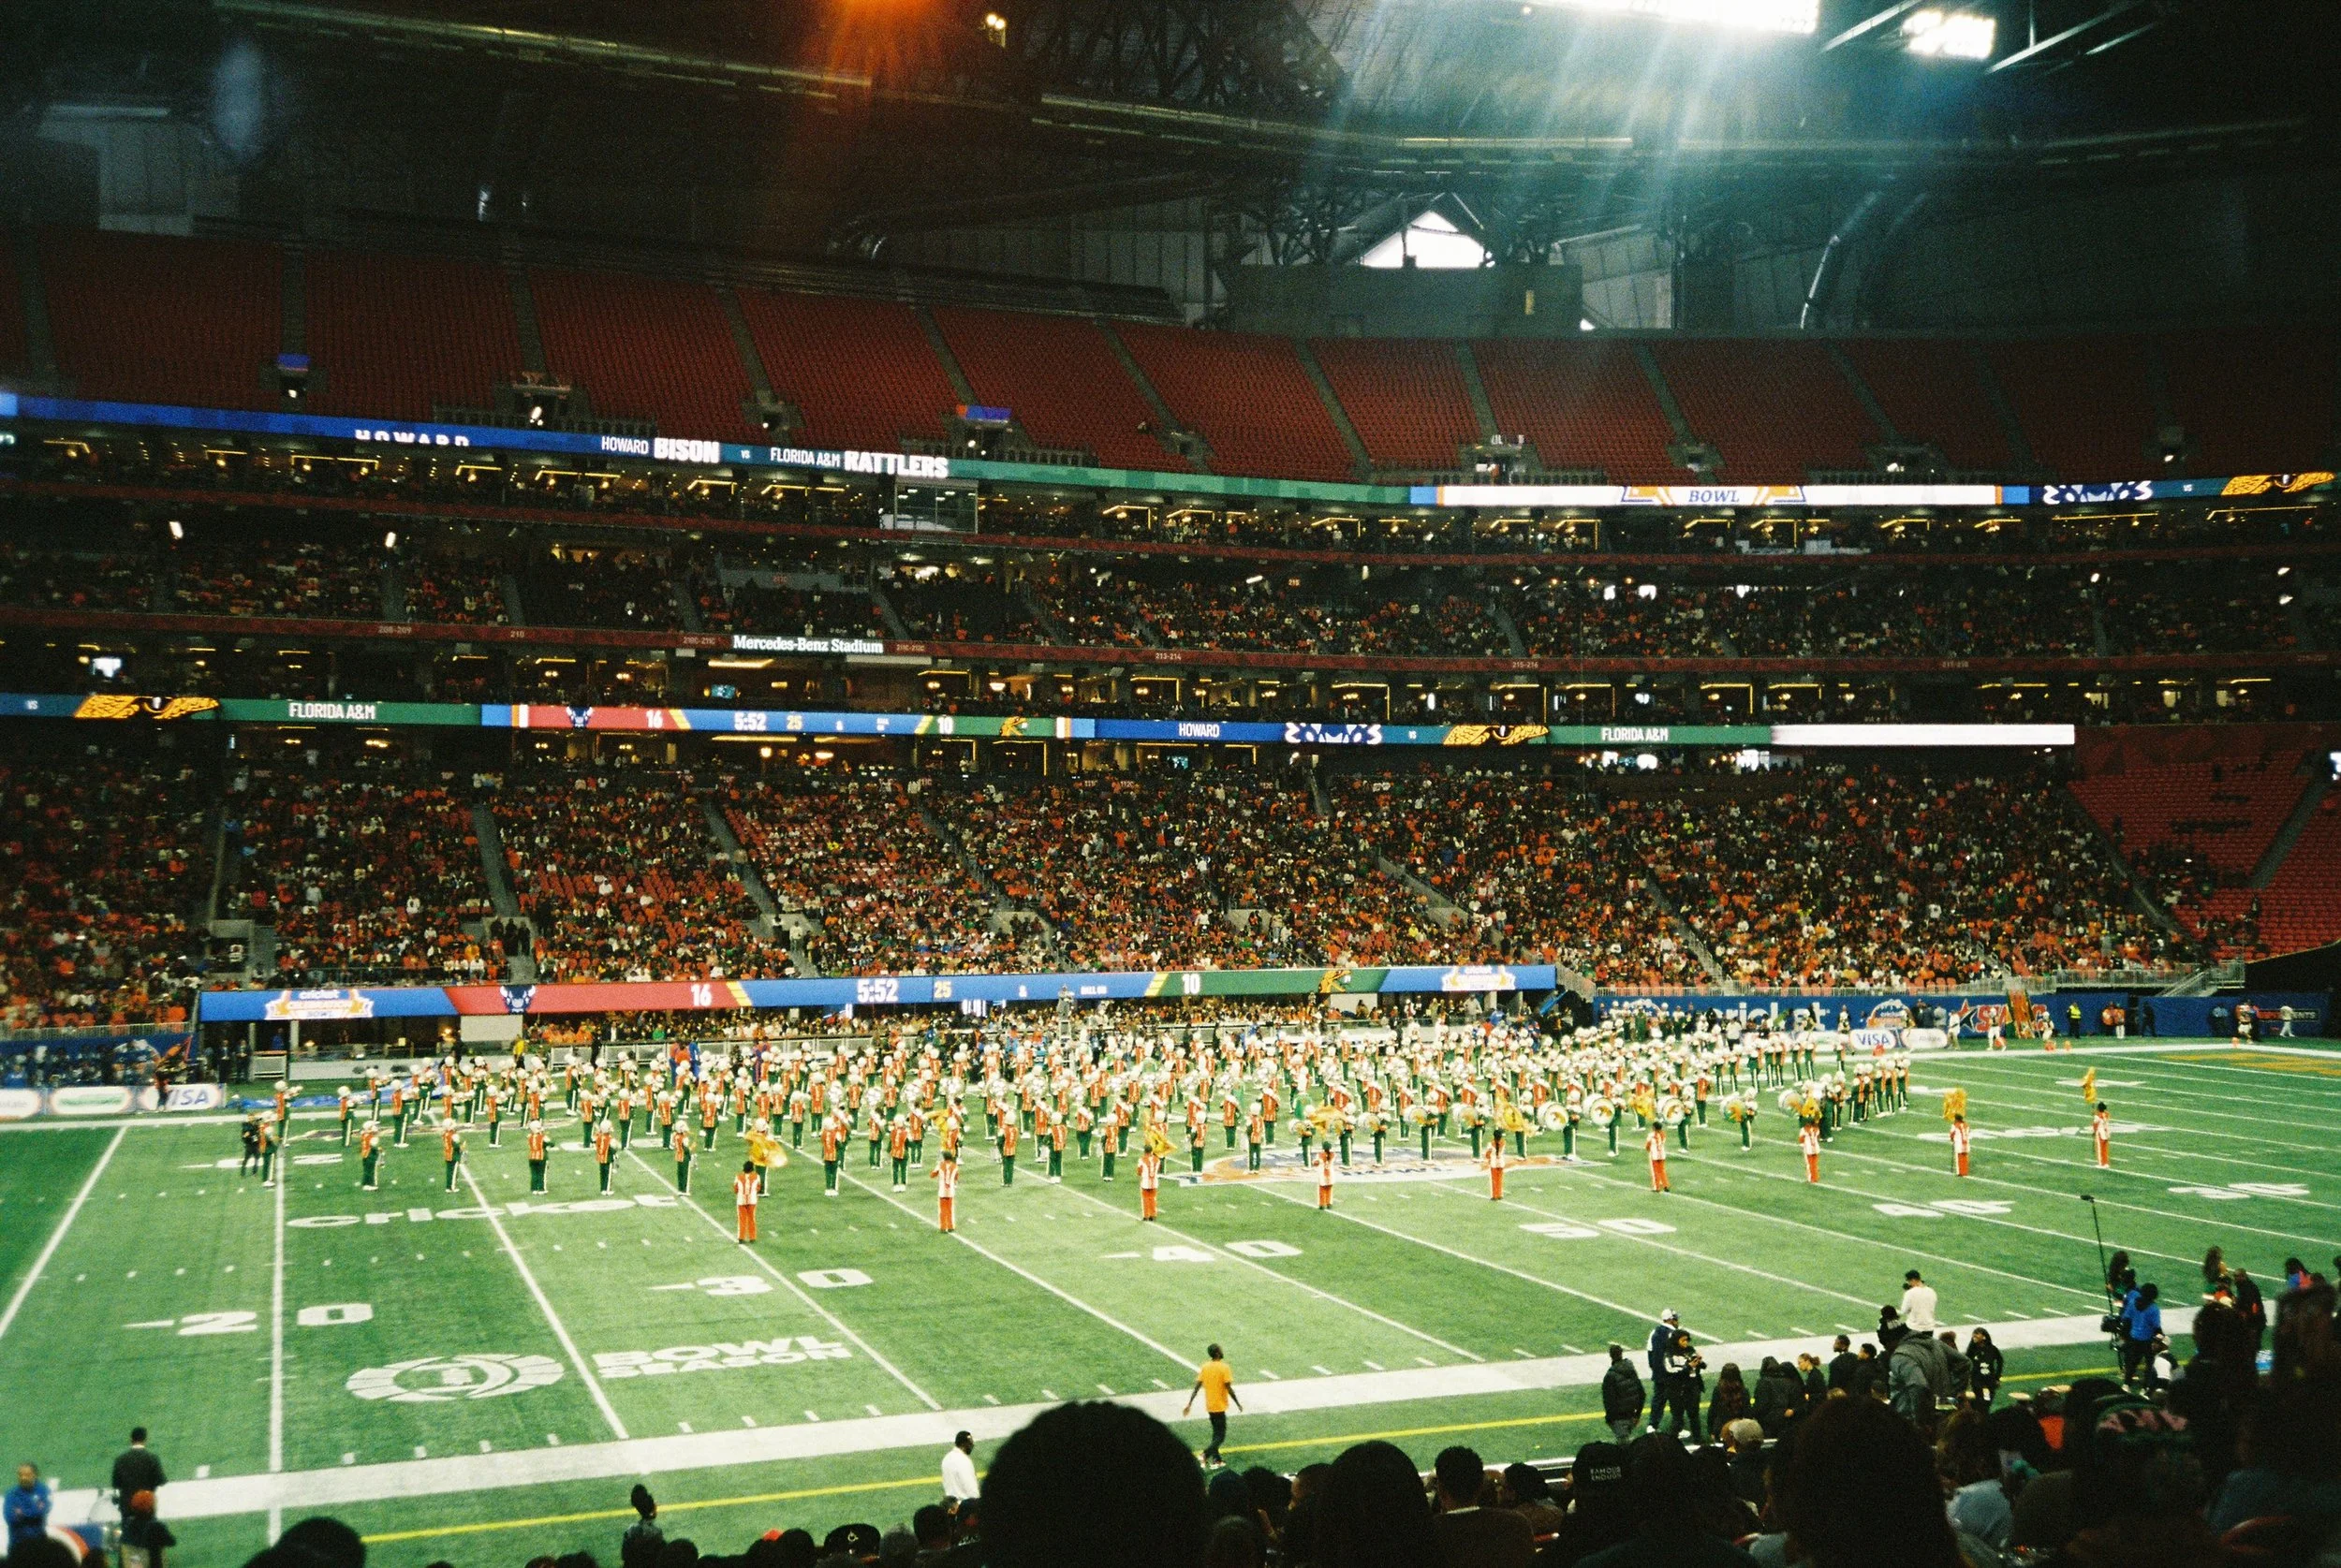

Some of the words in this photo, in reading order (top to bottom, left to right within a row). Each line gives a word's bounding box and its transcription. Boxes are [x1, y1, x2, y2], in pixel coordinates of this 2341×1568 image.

[601, 436, 648, 454] HOWARD
[655, 437, 719, 463] BISON
[770, 447, 815, 465] FLORIDA
[817, 452, 840, 468] A&M
[844, 451, 948, 479] RATTLERS
[1689, 490, 1741, 504] BOWL
[733, 635, 829, 652] Mercedes-Benz
[831, 637, 884, 653] Stadium
[288, 702, 344, 719] FLORIDA
[346, 704, 375, 720] A&M
[646, 711, 663, 728] 16
[734, 711, 766, 731] 5:52
[787, 714, 802, 731] 25
[937, 716, 953, 734] 10
[1178, 722, 1219, 738] HOWARD
[1601, 726, 1645, 741] FLORIDA
[1647, 727, 1669, 741] A&M
[691, 984, 712, 1006] 16
[857, 978, 898, 1003] 5:52
[934, 981, 952, 999] 25
[1182, 975, 1200, 995] 10
[1856, 1033, 1890, 1046] VISA
[287, 1194, 679, 1228] cricket
[1519, 1218, 1677, 1238] 50
[1152, 1240, 1303, 1263] 40
[697, 1268, 874, 1296] 30
[177, 1302, 373, 1336] 20
[592, 1336, 843, 1370] BOWL
[597, 1347, 853, 1379] SEASON
